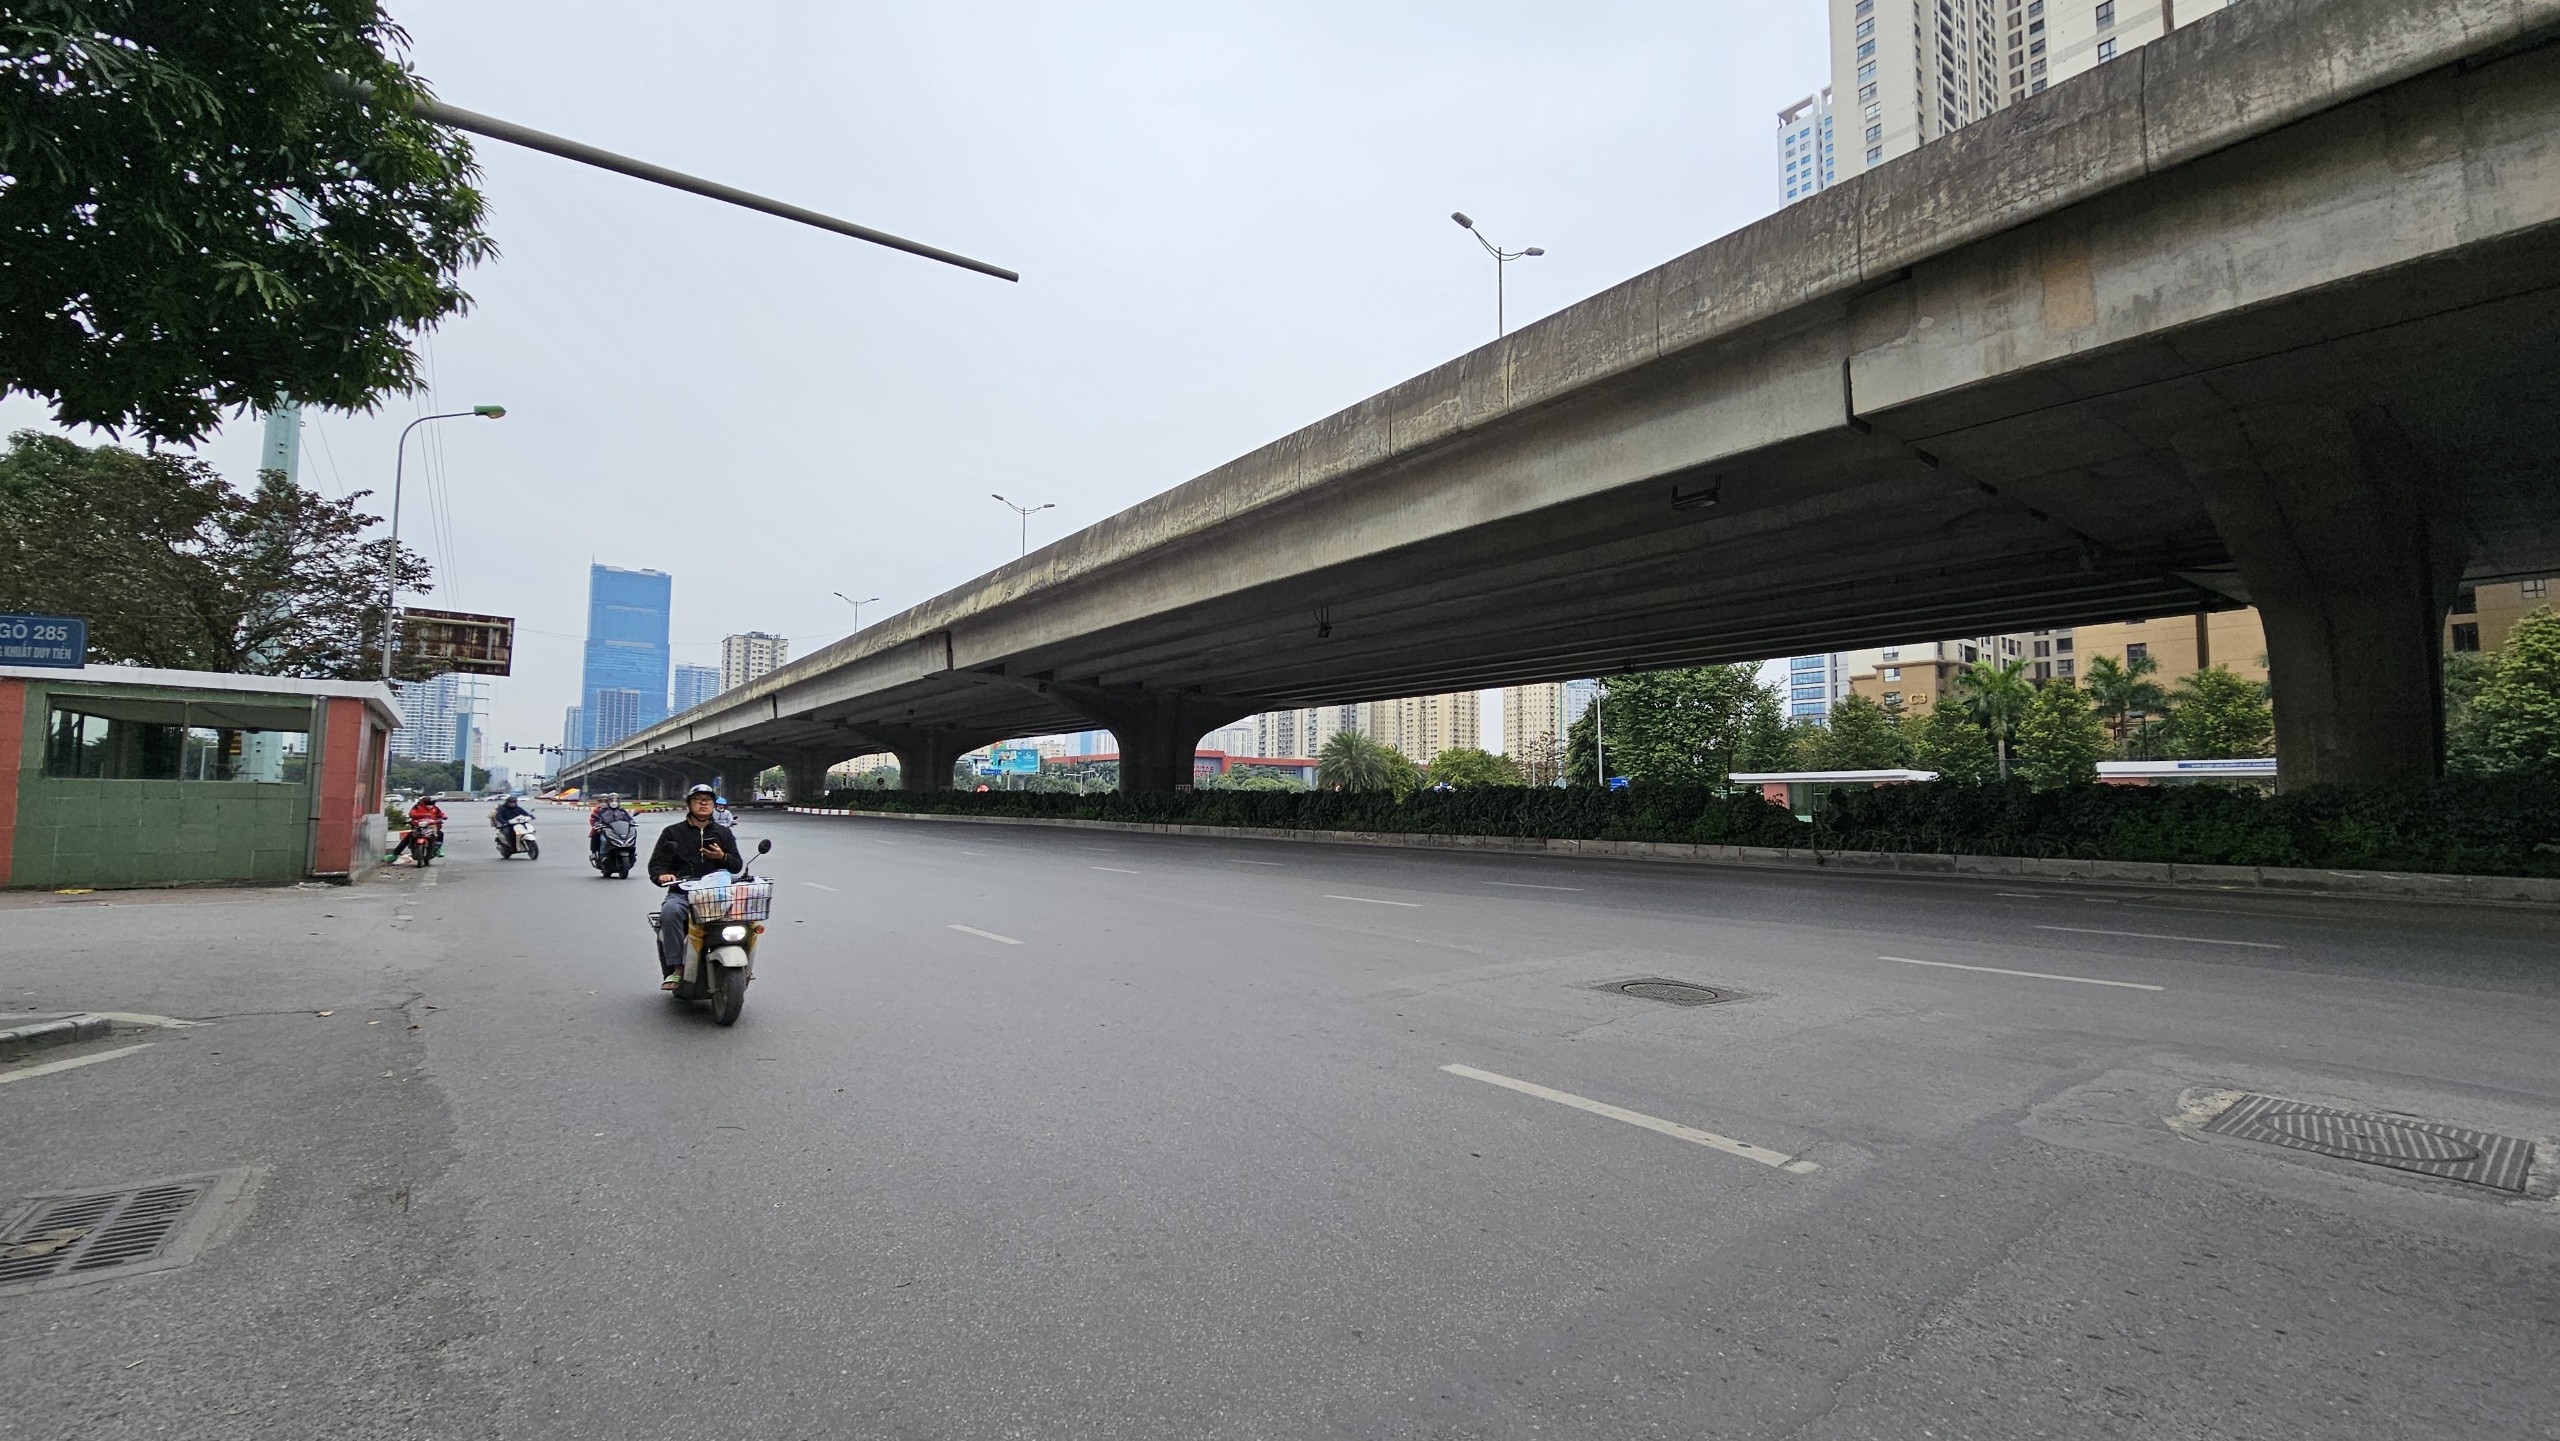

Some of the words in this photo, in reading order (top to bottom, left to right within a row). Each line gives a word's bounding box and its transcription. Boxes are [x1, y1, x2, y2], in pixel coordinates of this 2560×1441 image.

[0, 620, 28, 639] GÕ
[33, 625, 67, 641] 285
[4, 641, 32, 657] KHUẤT
[33, 647, 51, 659] DUY
[1909, 693, 1928, 705] C3
